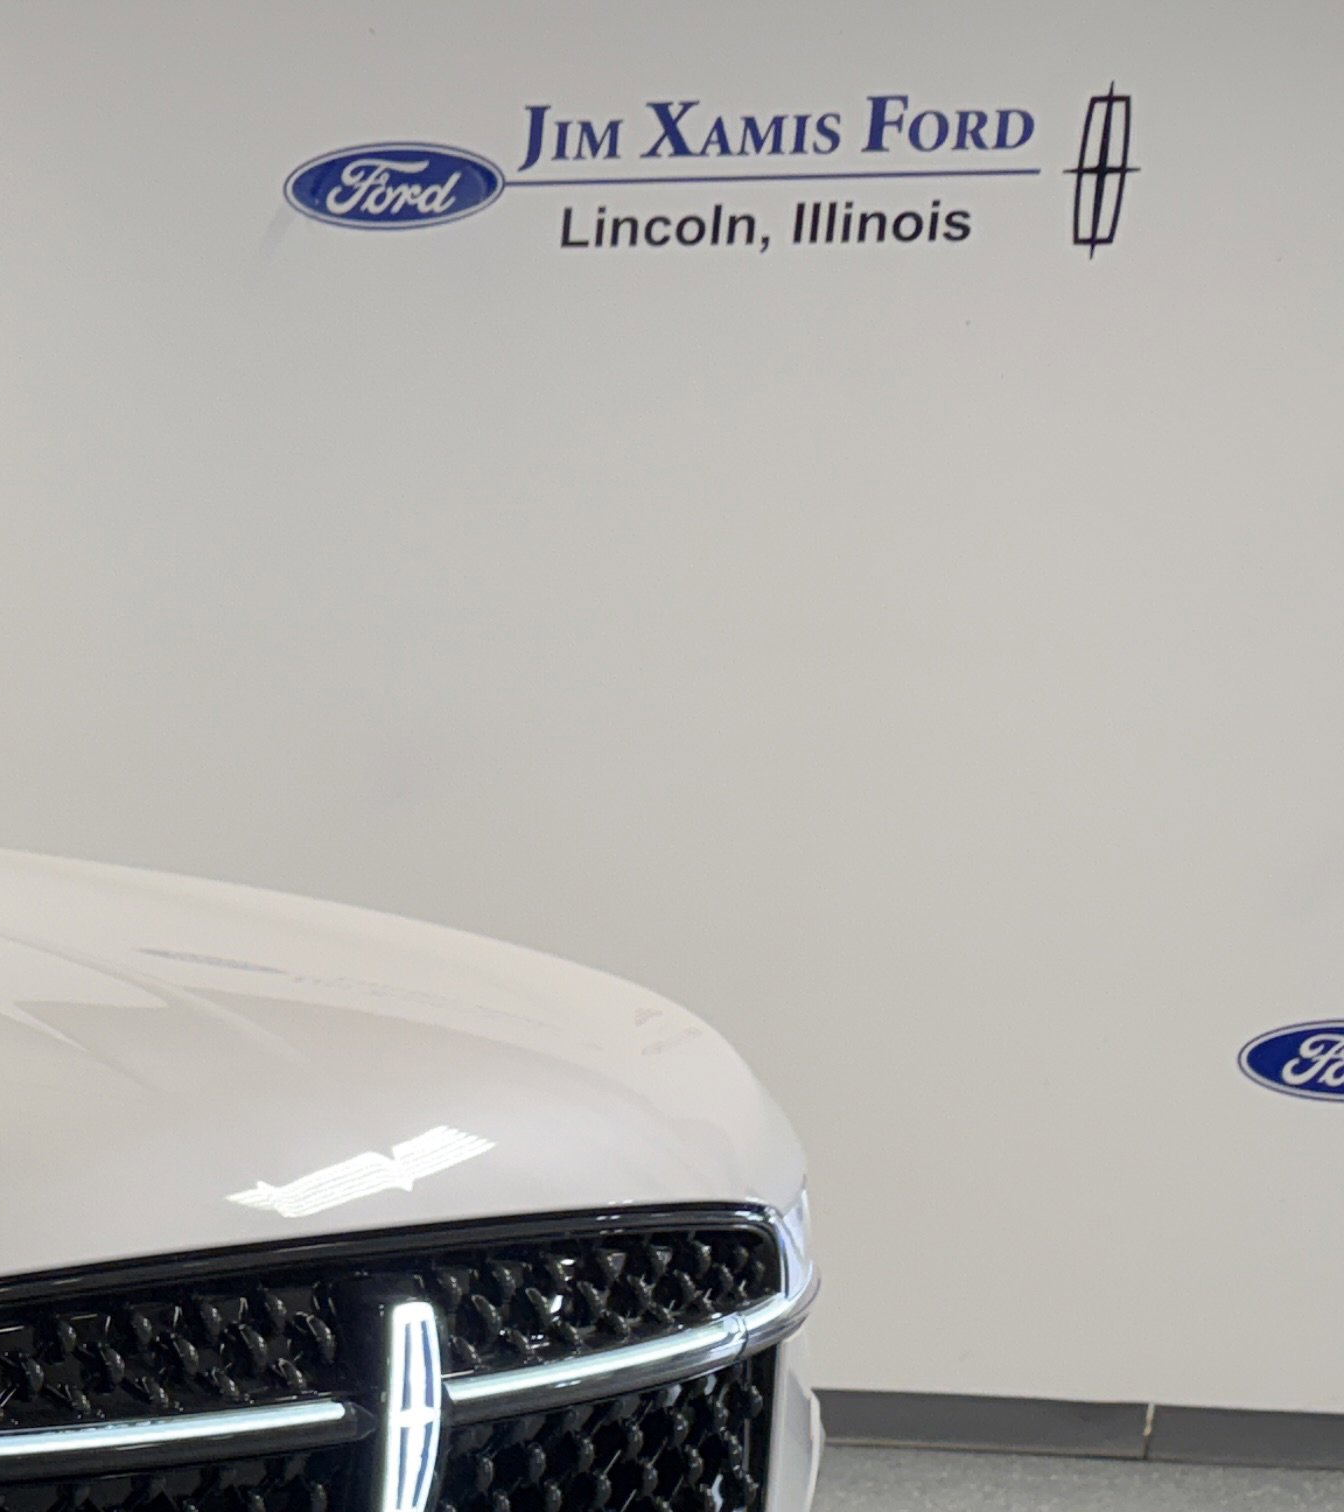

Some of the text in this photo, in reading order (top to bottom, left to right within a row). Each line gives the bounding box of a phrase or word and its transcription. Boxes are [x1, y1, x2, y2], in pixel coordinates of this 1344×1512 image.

[517, 94, 1036, 172] JIM XAMIS FORD
[325, 156, 462, 216] Ford
[560, 198, 973, 254] Lincoln, Illinois
